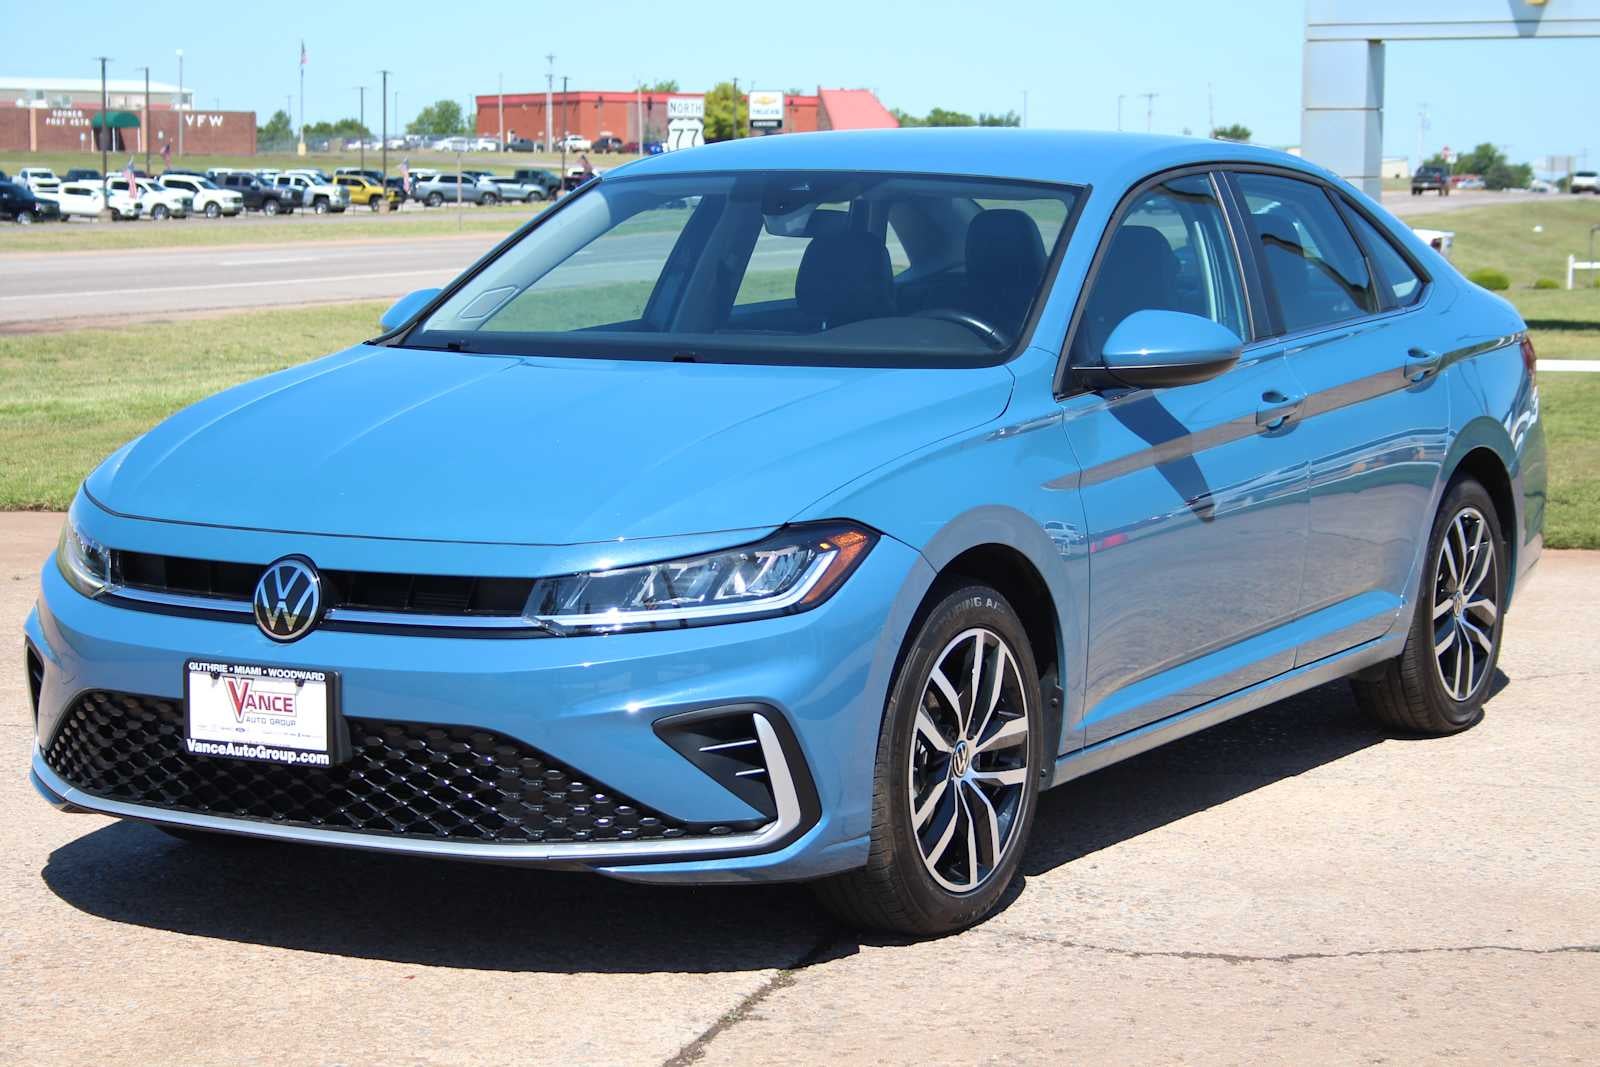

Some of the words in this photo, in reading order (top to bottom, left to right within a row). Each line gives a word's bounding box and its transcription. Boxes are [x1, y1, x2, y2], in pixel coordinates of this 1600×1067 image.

[670, 101, 702, 113] NORTH
[185, 114, 224, 128] VFW
[672, 128, 699, 150] 77
[188, 661, 228, 673] GUTHRIE
[234, 665, 262, 676] MIAMI
[268, 668, 326, 681] WOODWARD
[224, 676, 294, 722] VANCE
[246, 715, 267, 725] AUTO
[269, 718, 297, 727] GROUP
[186, 738, 330, 765] VanceAutoGroup.com
